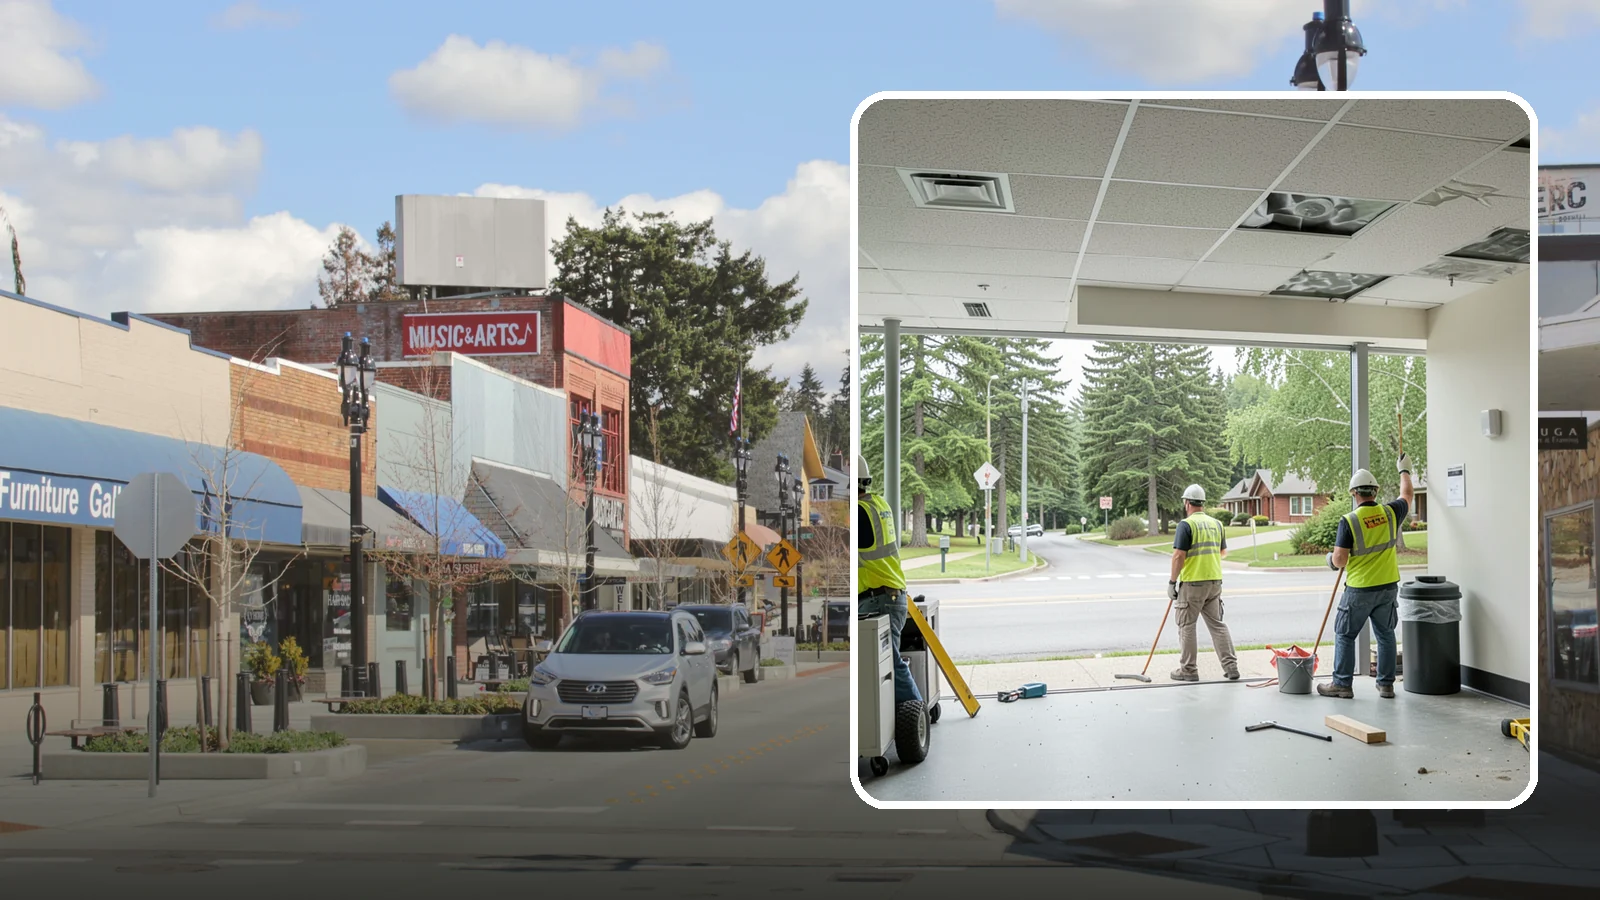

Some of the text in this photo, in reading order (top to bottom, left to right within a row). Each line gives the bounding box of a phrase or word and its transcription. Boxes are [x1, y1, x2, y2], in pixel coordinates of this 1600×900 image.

[408, 322, 520, 349] MUSIC&ARTS
[1540, 427, 1578, 437] UGA
[0, 471, 122, 519] Furniture Gal
[453, 563, 480, 574] SUSHI
